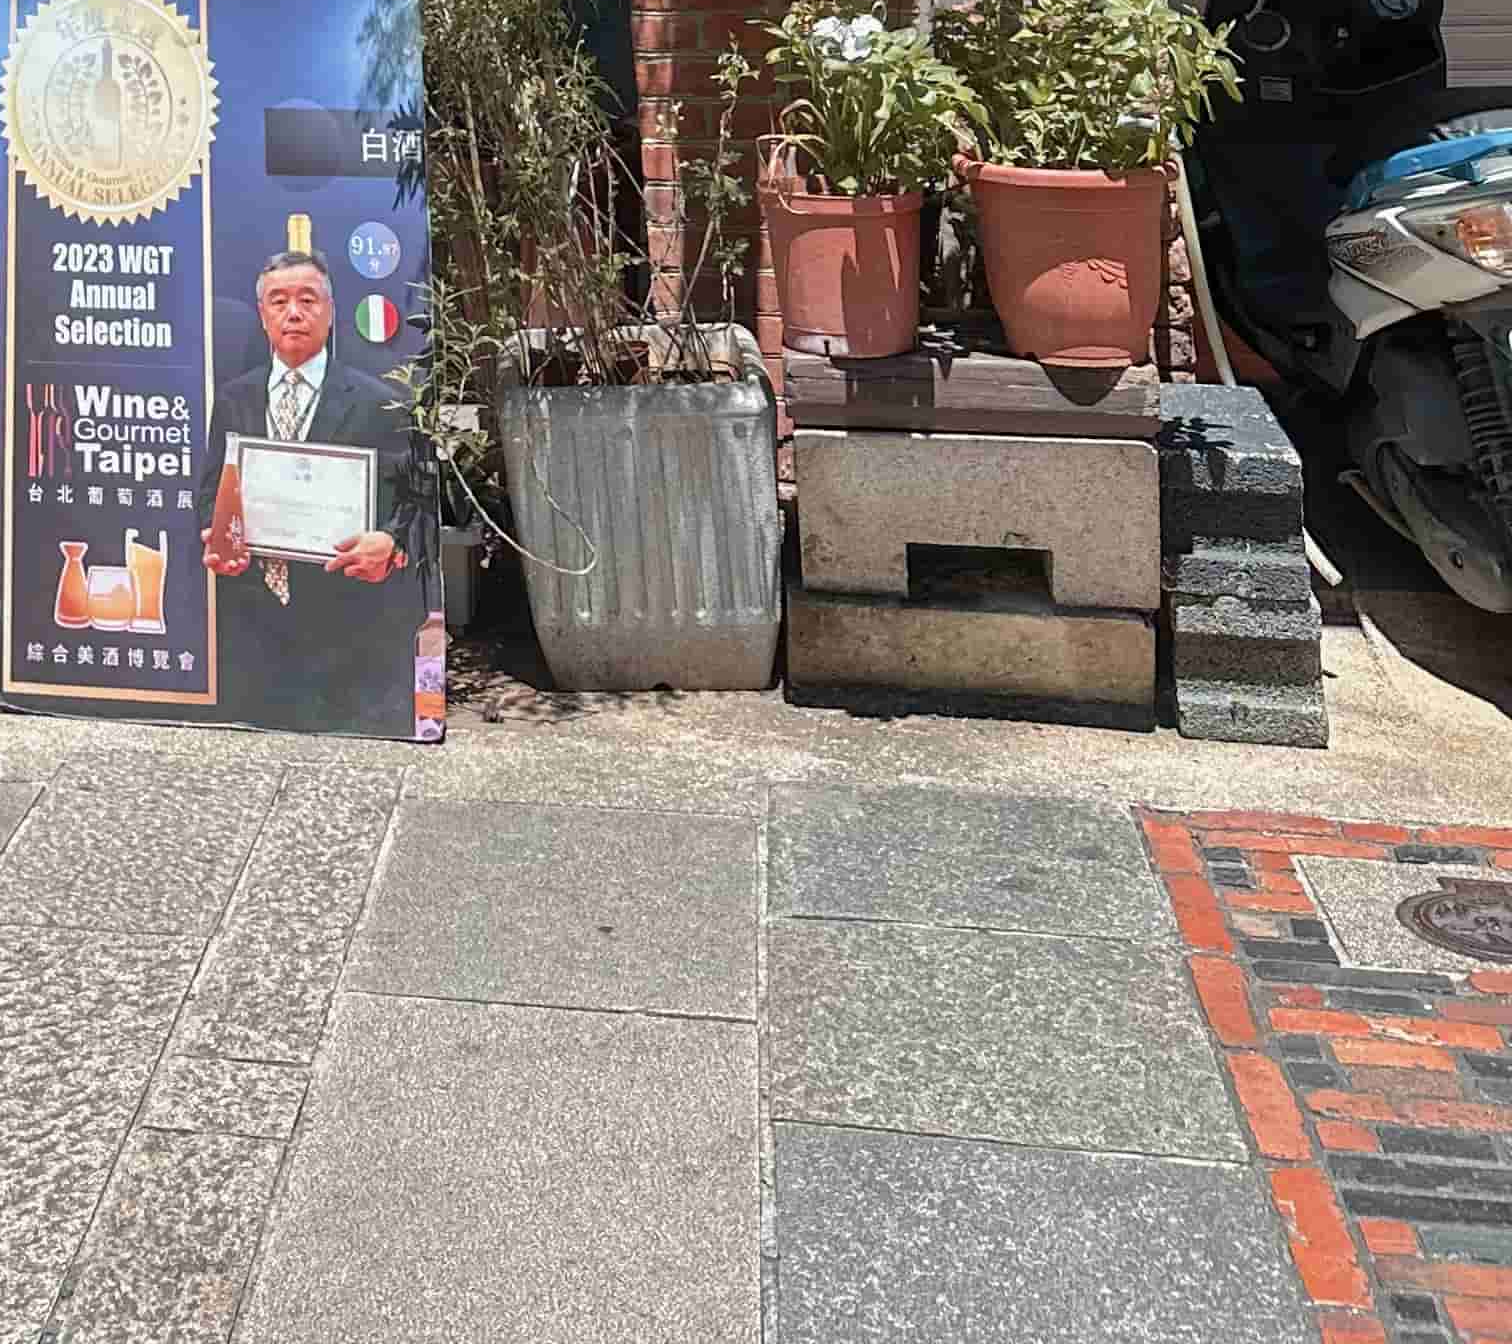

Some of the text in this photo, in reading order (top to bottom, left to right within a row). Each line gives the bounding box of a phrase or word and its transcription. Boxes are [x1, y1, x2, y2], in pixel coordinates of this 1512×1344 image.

[361, 127, 424, 164] 白酒
[52, 243, 174, 275] 2023 WGT
[70, 279, 155, 311] Annual
[54, 314, 173, 348] Selection
[74, 417, 192, 443] Gourmet
[74, 442, 192, 481] Taipei
[28, 482, 194, 509] 台北葡萄酒展
[26, 641, 195, 672] 綜合美酒博覽會
